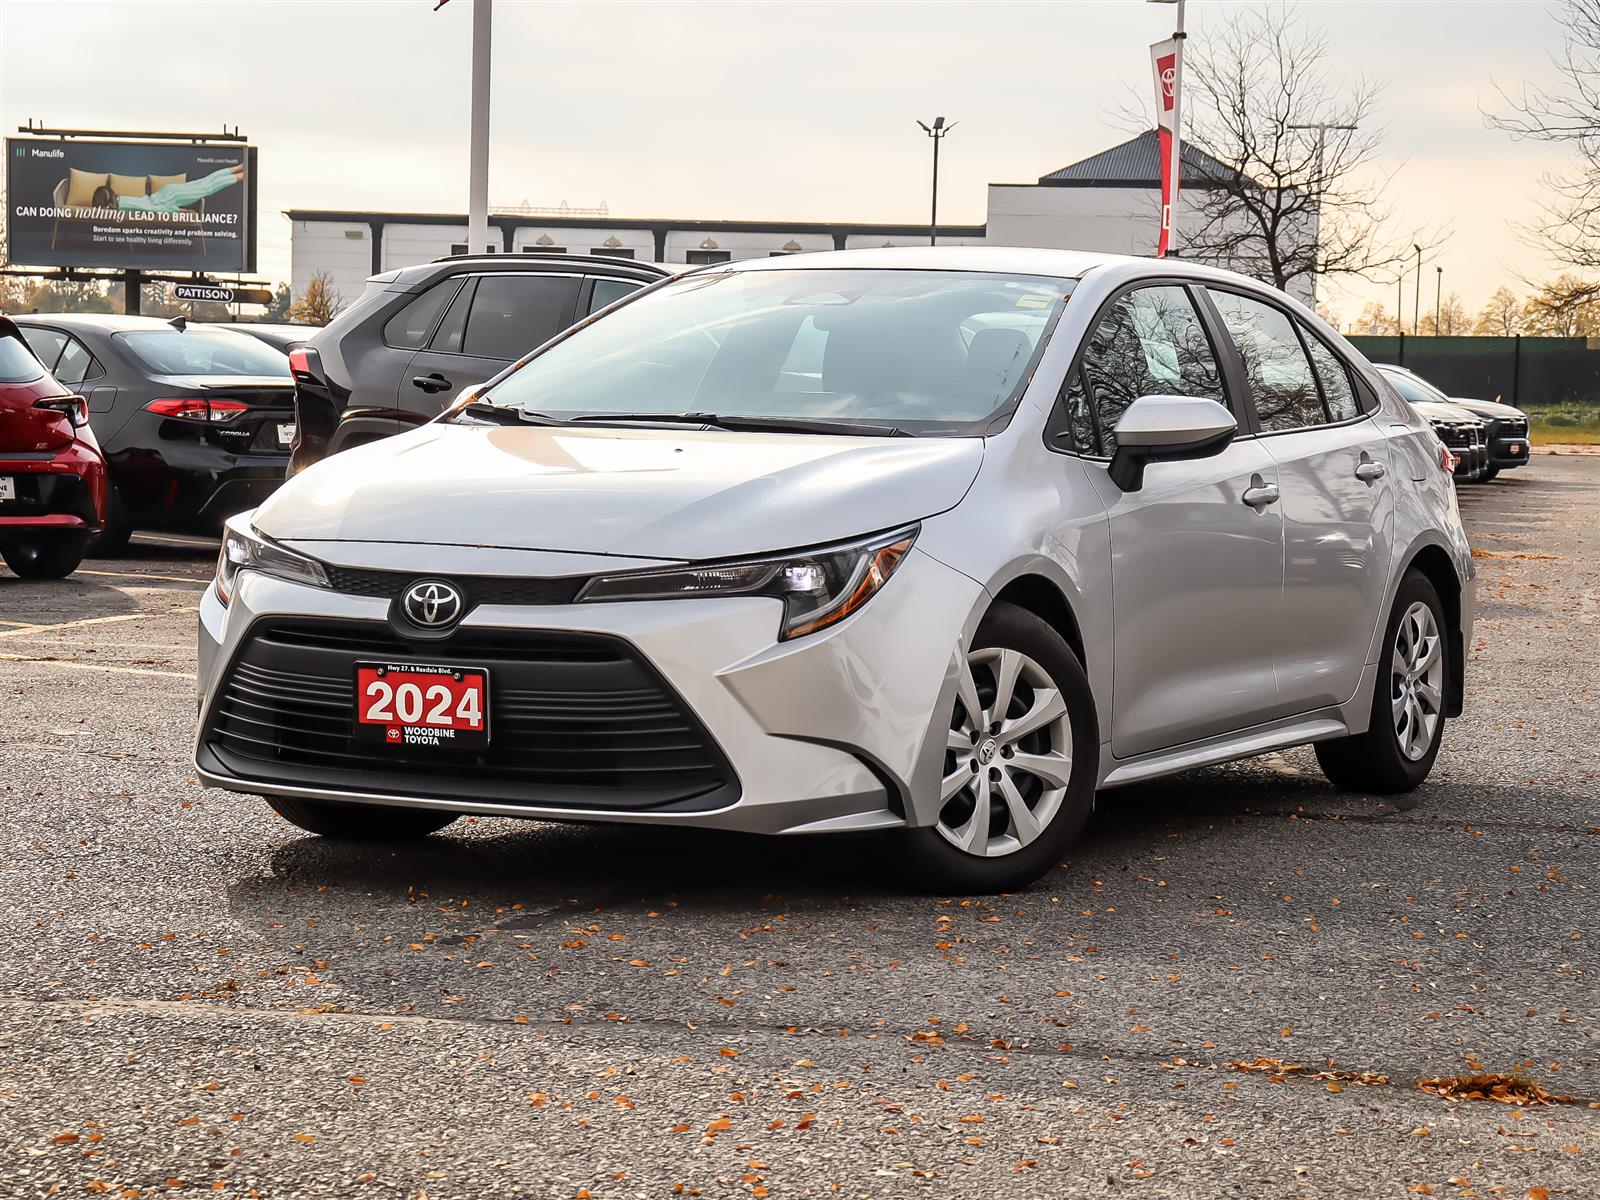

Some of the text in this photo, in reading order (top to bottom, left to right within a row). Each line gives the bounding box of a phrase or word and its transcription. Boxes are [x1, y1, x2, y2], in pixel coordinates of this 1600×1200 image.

[31, 149, 65, 158] Manulife
[16, 205, 238, 224] CAN DOING nothing LEAD TO BRILLIANCE?
[126, 236, 147, 244] healthy
[147, 237, 162, 245] living
[214, 231, 238, 239] solving.
[178, 288, 229, 300] PATTISON
[387, 664, 401, 673] Hwy
[415, 666, 438, 674] Rexdale
[438, 667, 453, 675] Blvd.
[366, 680, 482, 727] 2024
[404, 726, 455, 738] WOODBINE
[404, 735, 440, 746] TOYOTA
